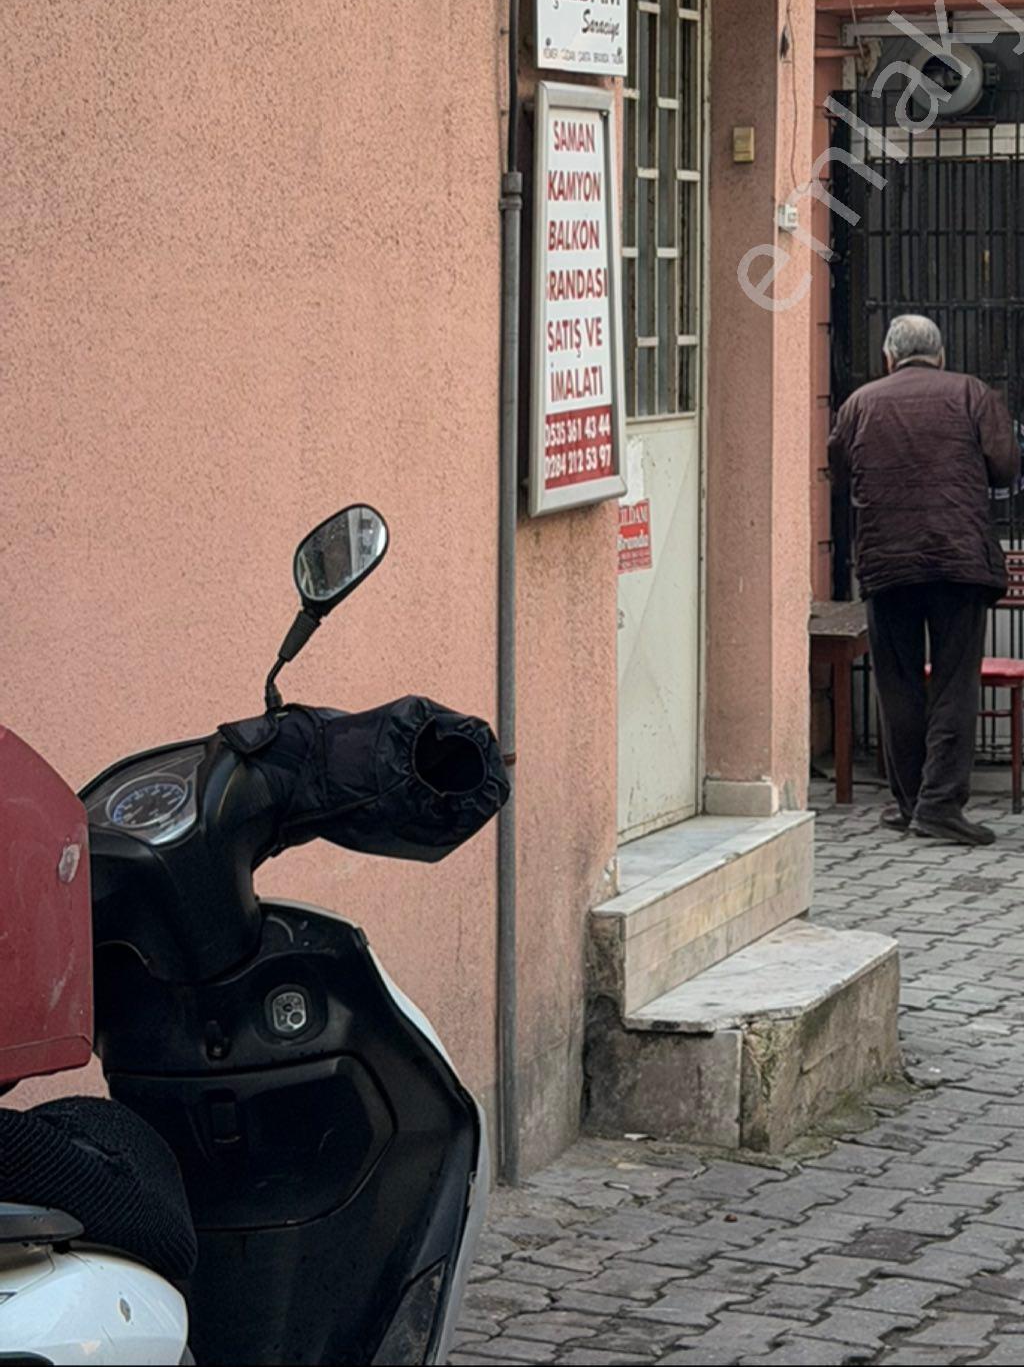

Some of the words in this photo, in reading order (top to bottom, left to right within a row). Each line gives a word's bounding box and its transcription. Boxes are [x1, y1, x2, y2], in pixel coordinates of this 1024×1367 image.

[553, 120, 595, 152] SAMAN
[548, 170, 601, 201] KAMYON
[548, 220, 600, 250] BALKON
[547, 319, 582, 358] SATIŞ
[585, 317, 603, 346] VE
[550, 362, 603, 402] İMALATI
